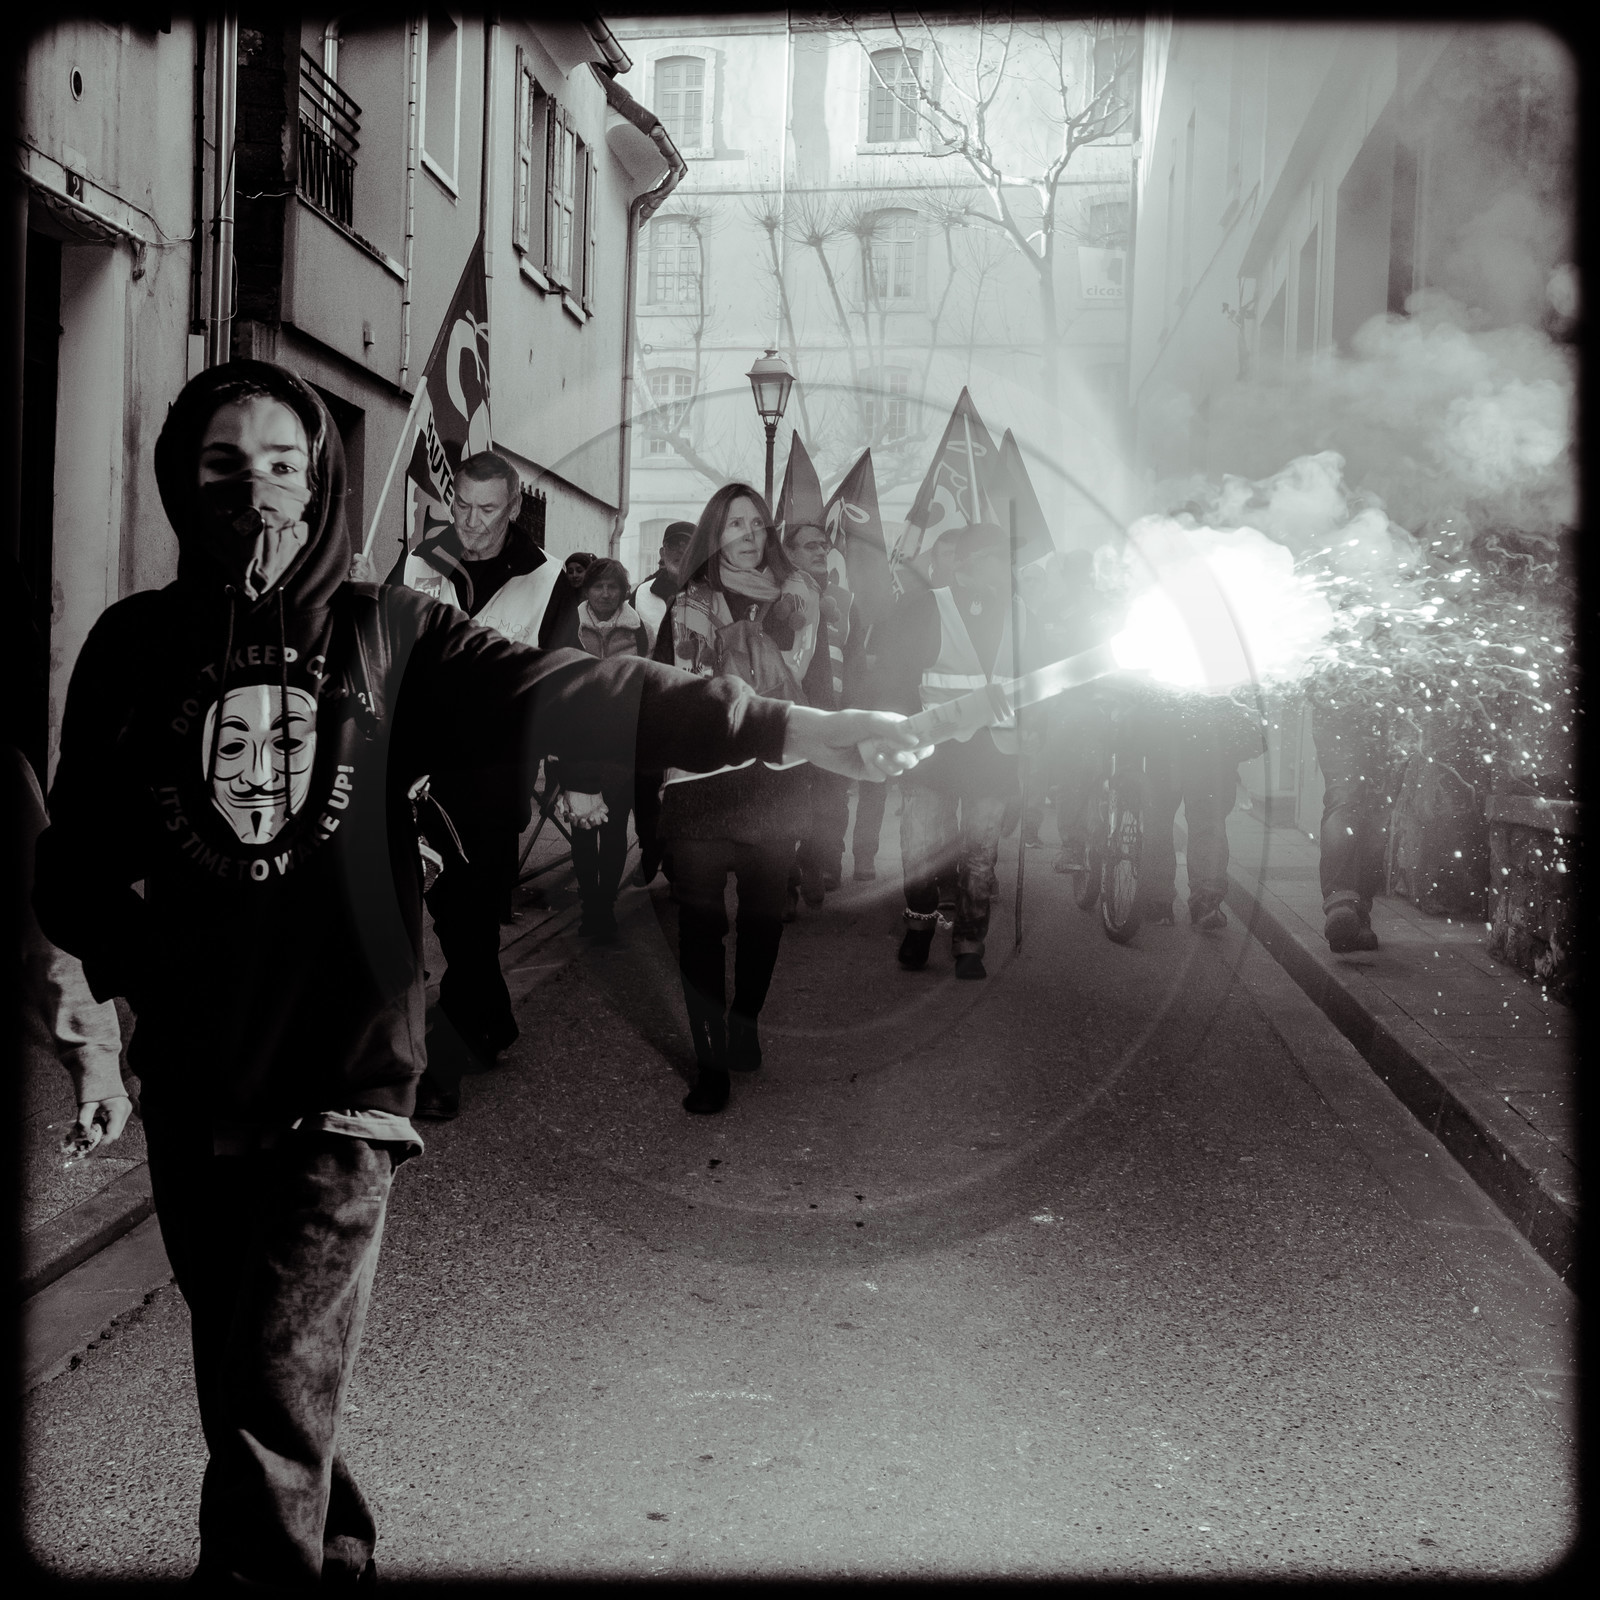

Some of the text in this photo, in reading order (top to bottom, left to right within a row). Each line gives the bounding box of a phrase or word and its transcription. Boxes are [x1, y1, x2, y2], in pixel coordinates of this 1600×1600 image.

[72, 175, 80, 200] 2
[1086, 285, 1122, 297] cicas
[228, 644, 299, 671] KEEP
[158, 764, 355, 882] IT'S TIME TO WAKE UP!
